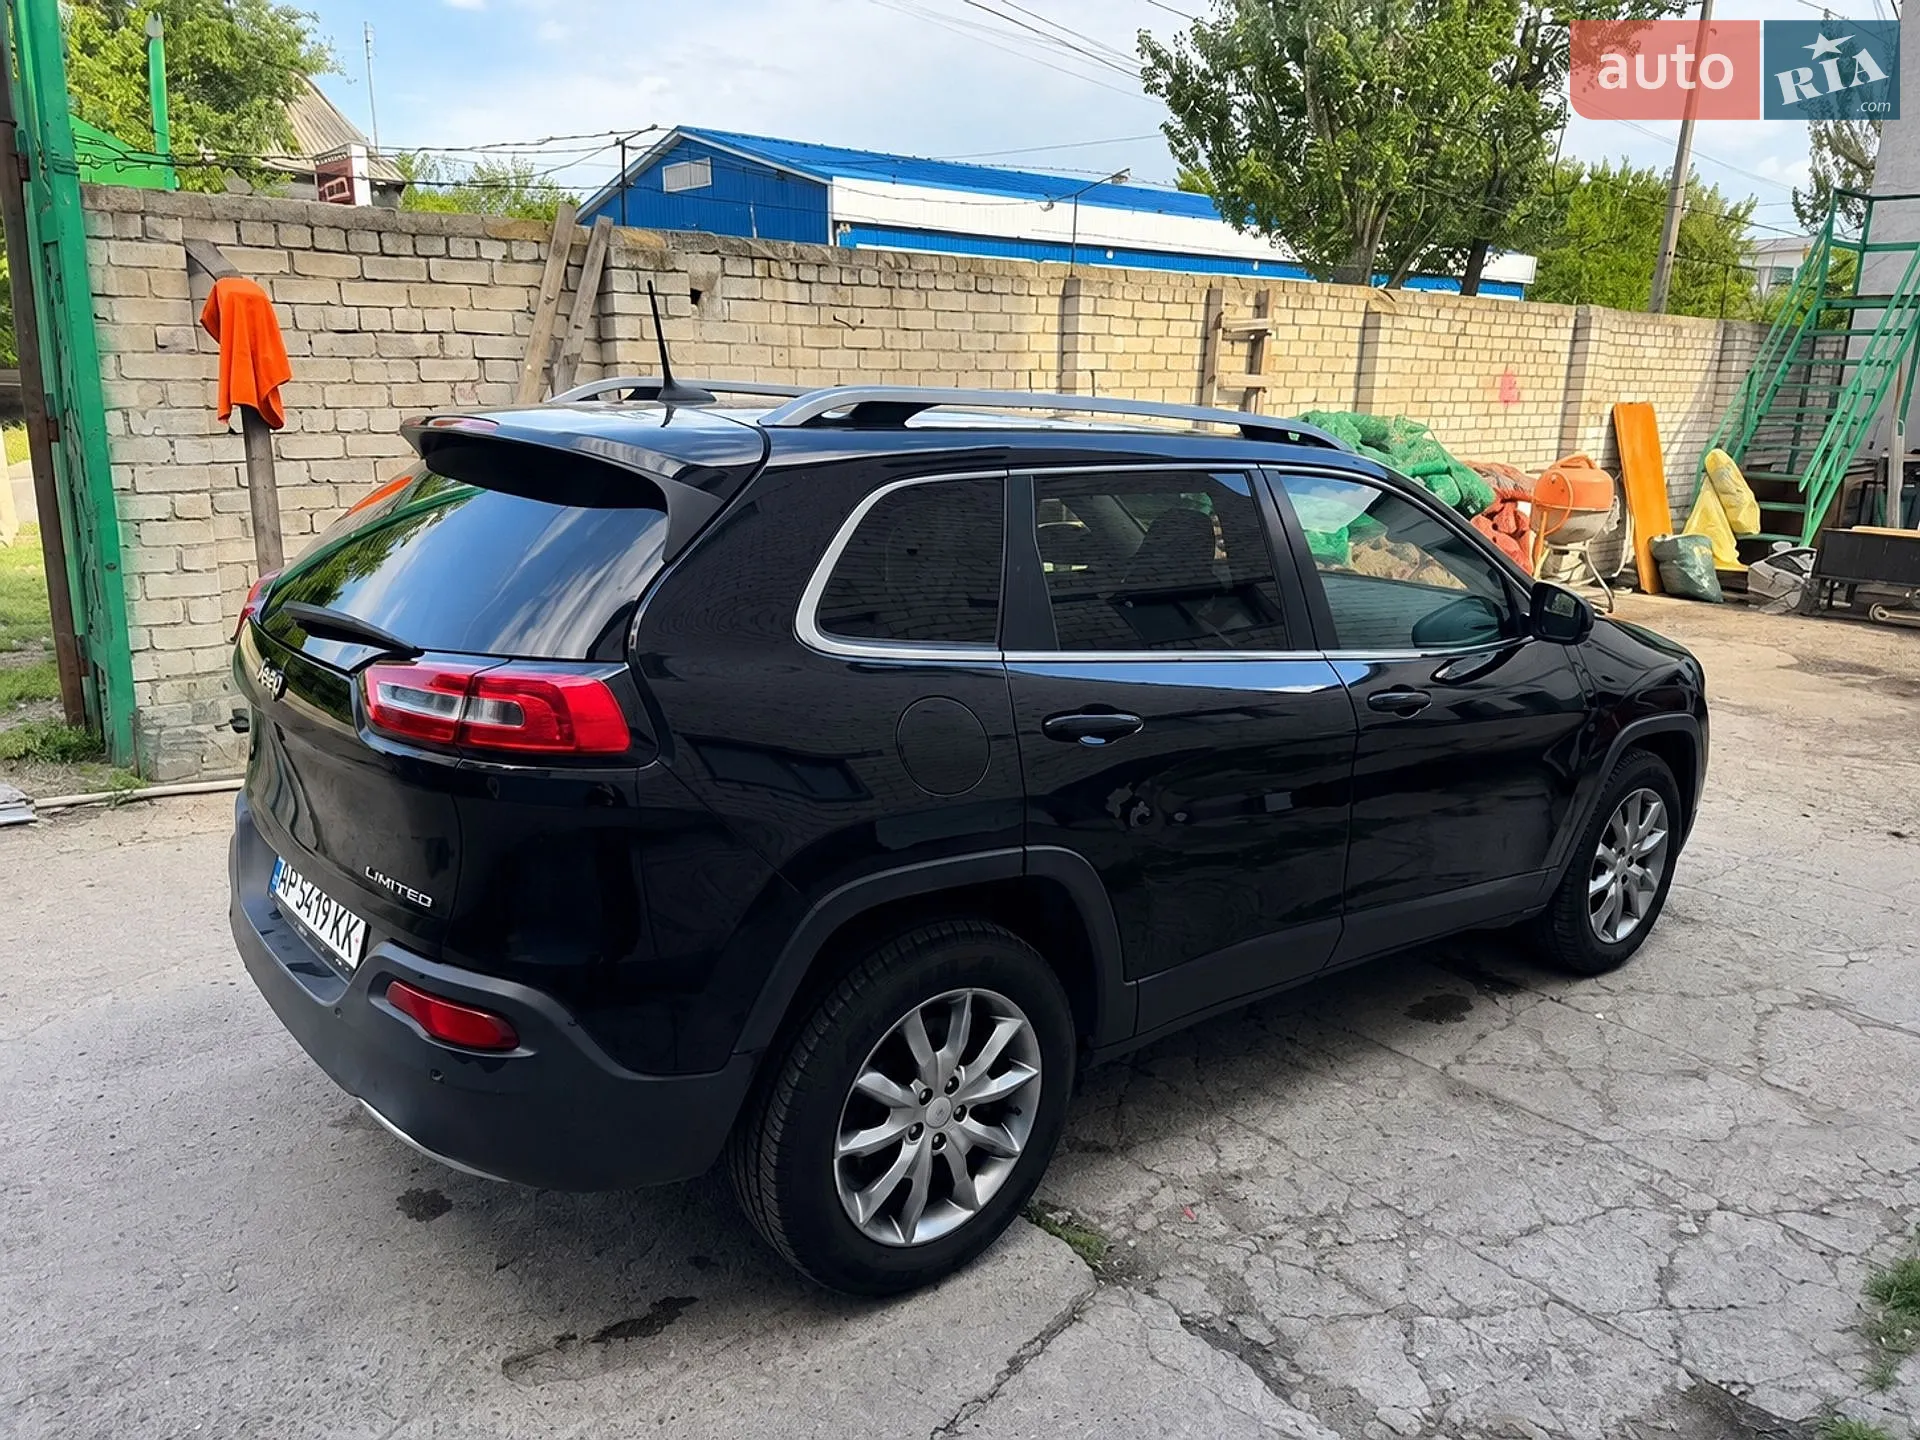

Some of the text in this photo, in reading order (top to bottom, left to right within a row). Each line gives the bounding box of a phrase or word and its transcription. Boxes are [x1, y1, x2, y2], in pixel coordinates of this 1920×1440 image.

[257, 657, 284, 702] Jeep
[295, 880, 332, 931] 5419
[365, 866, 433, 907] LIMITED
